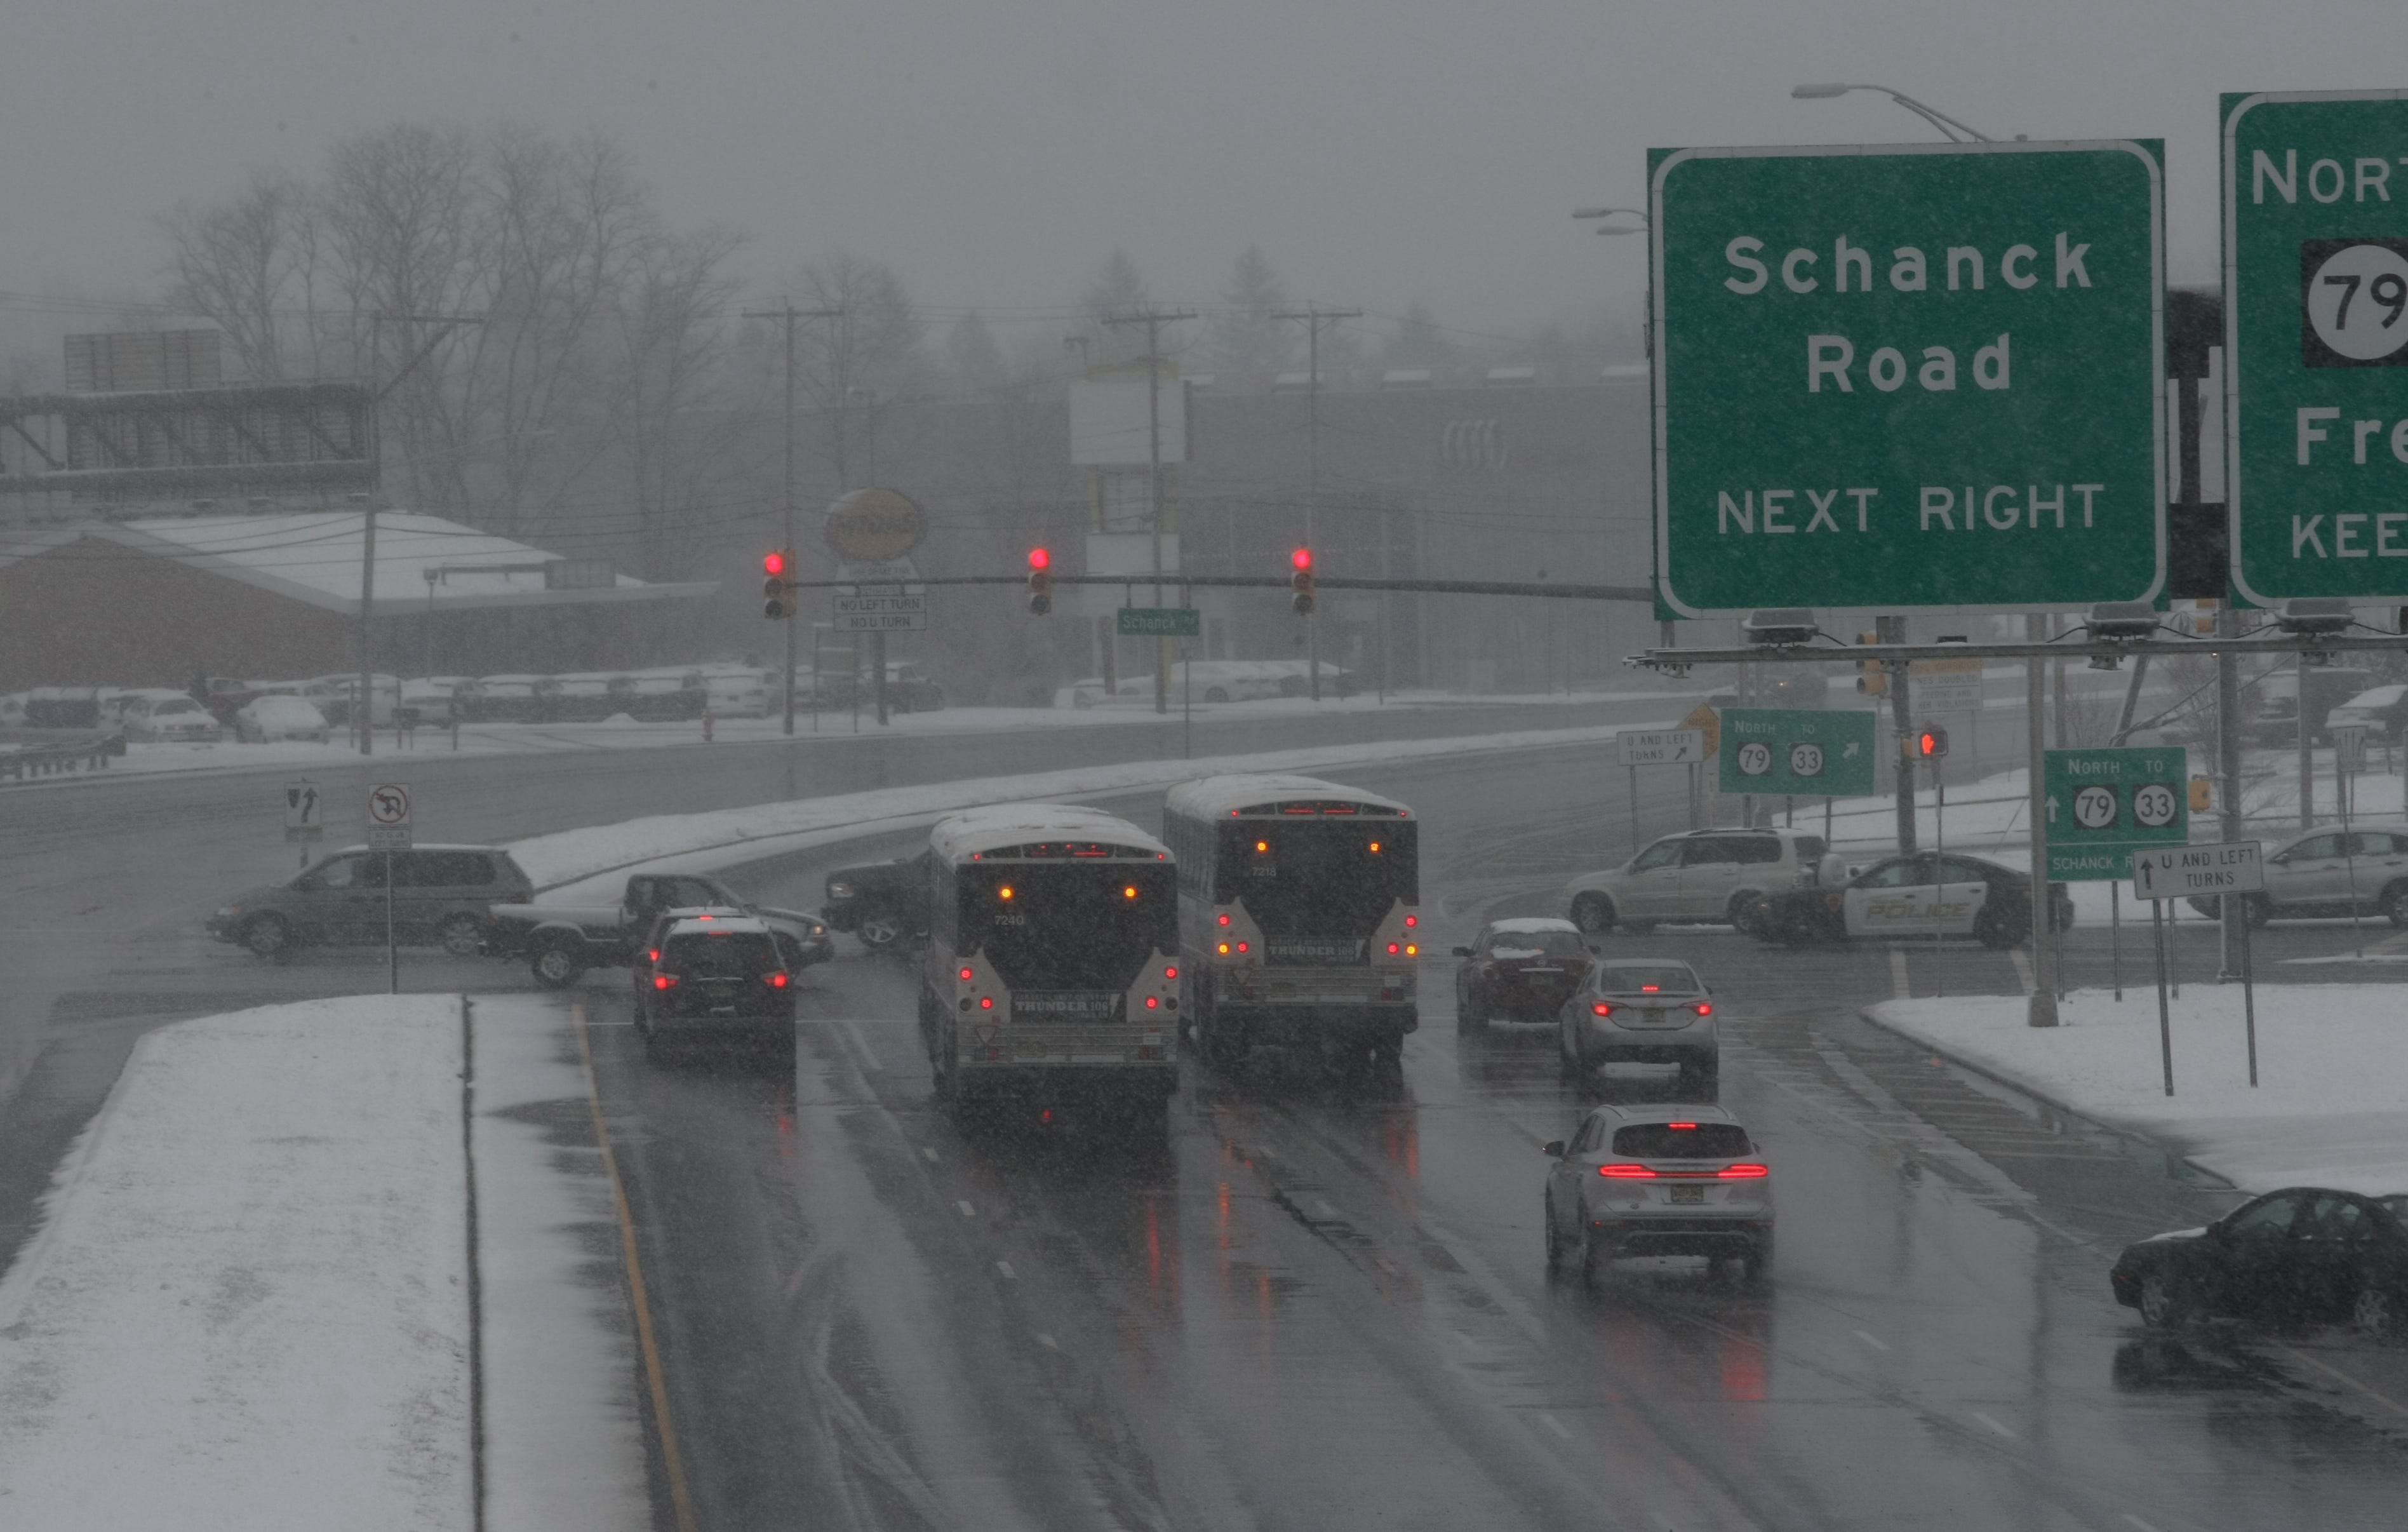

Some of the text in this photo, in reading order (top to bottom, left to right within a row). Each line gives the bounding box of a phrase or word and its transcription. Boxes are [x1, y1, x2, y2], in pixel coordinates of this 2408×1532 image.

[2252, 148, 2408, 204] NOR
[1723, 231, 2092, 295] Schanck
[2324, 273, 2408, 330] 79
[1807, 332, 2012, 393] Road
[1718, 483, 2105, 534] NEXT RIGHT
[2292, 513, 2408, 559] KEE
[841, 598, 920, 610] NO LEFT TURN
[850, 616, 911, 628] NO U TURN
[1123, 614, 1176, 629] Schanck
[1735, 720, 1816, 735] NORTH TO
[1627, 736, 1635, 746] U
[1640, 735, 1662, 746] AND
[1666, 734, 1693, 744] LEFT
[1629, 749, 1664, 761] TURNS
[1743, 749, 1766, 768] 79
[1796, 751, 1819, 770] 33
[2068, 759, 2164, 775] NORTH TO
[2080, 795, 2110, 819] 79
[2141, 793, 2171, 818] 33
[2052, 856, 2133, 870] SCHANCK R
[2162, 849, 2254, 869] U AND LEFT
[1252, 866, 1276, 876] 7218
[2186, 871, 2235, 888] TURNS
[994, 915, 1024, 925] 7240
[1866, 903, 1970, 920] POLICE
[1268, 946, 1354, 955] THUNDER 106
[1015, 1001, 1108, 1011] THUNDER 106
